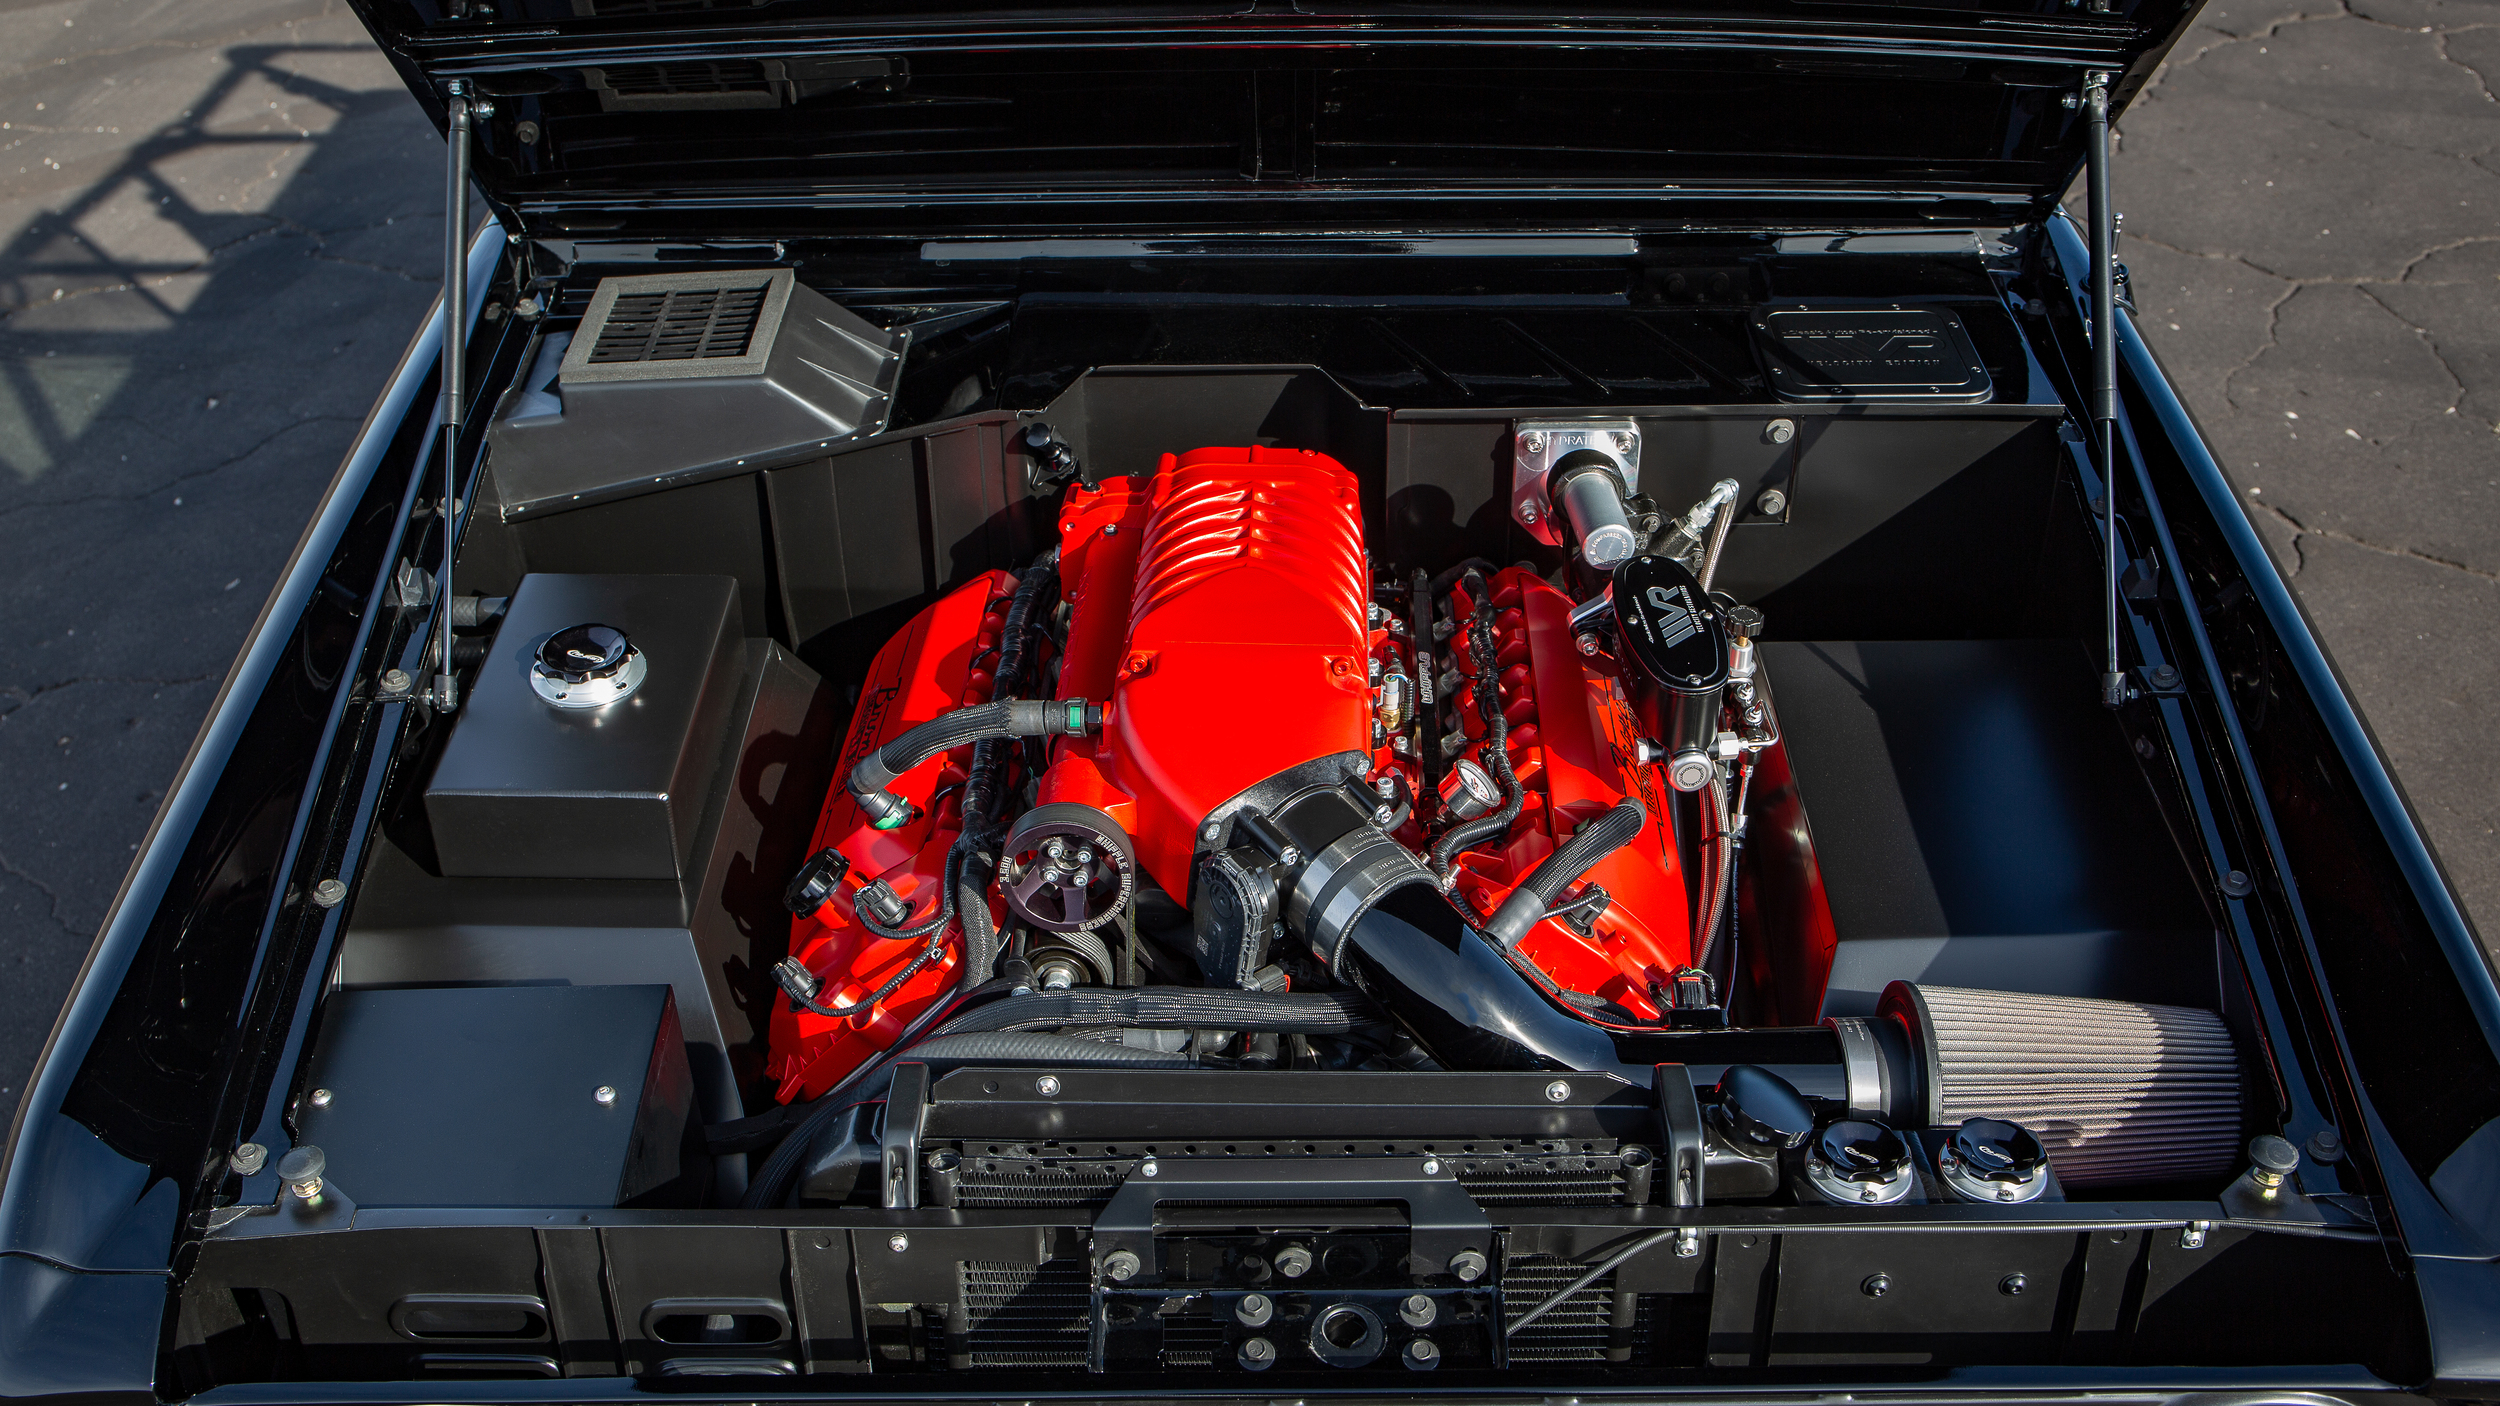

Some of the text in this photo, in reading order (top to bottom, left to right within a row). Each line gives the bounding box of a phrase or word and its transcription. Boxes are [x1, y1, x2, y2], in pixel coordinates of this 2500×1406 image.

[1418, 651, 1434, 704] WHIPPLE
[857, 677, 903, 760] Bron
[1095, 834, 1129, 870] WHIPPLE
